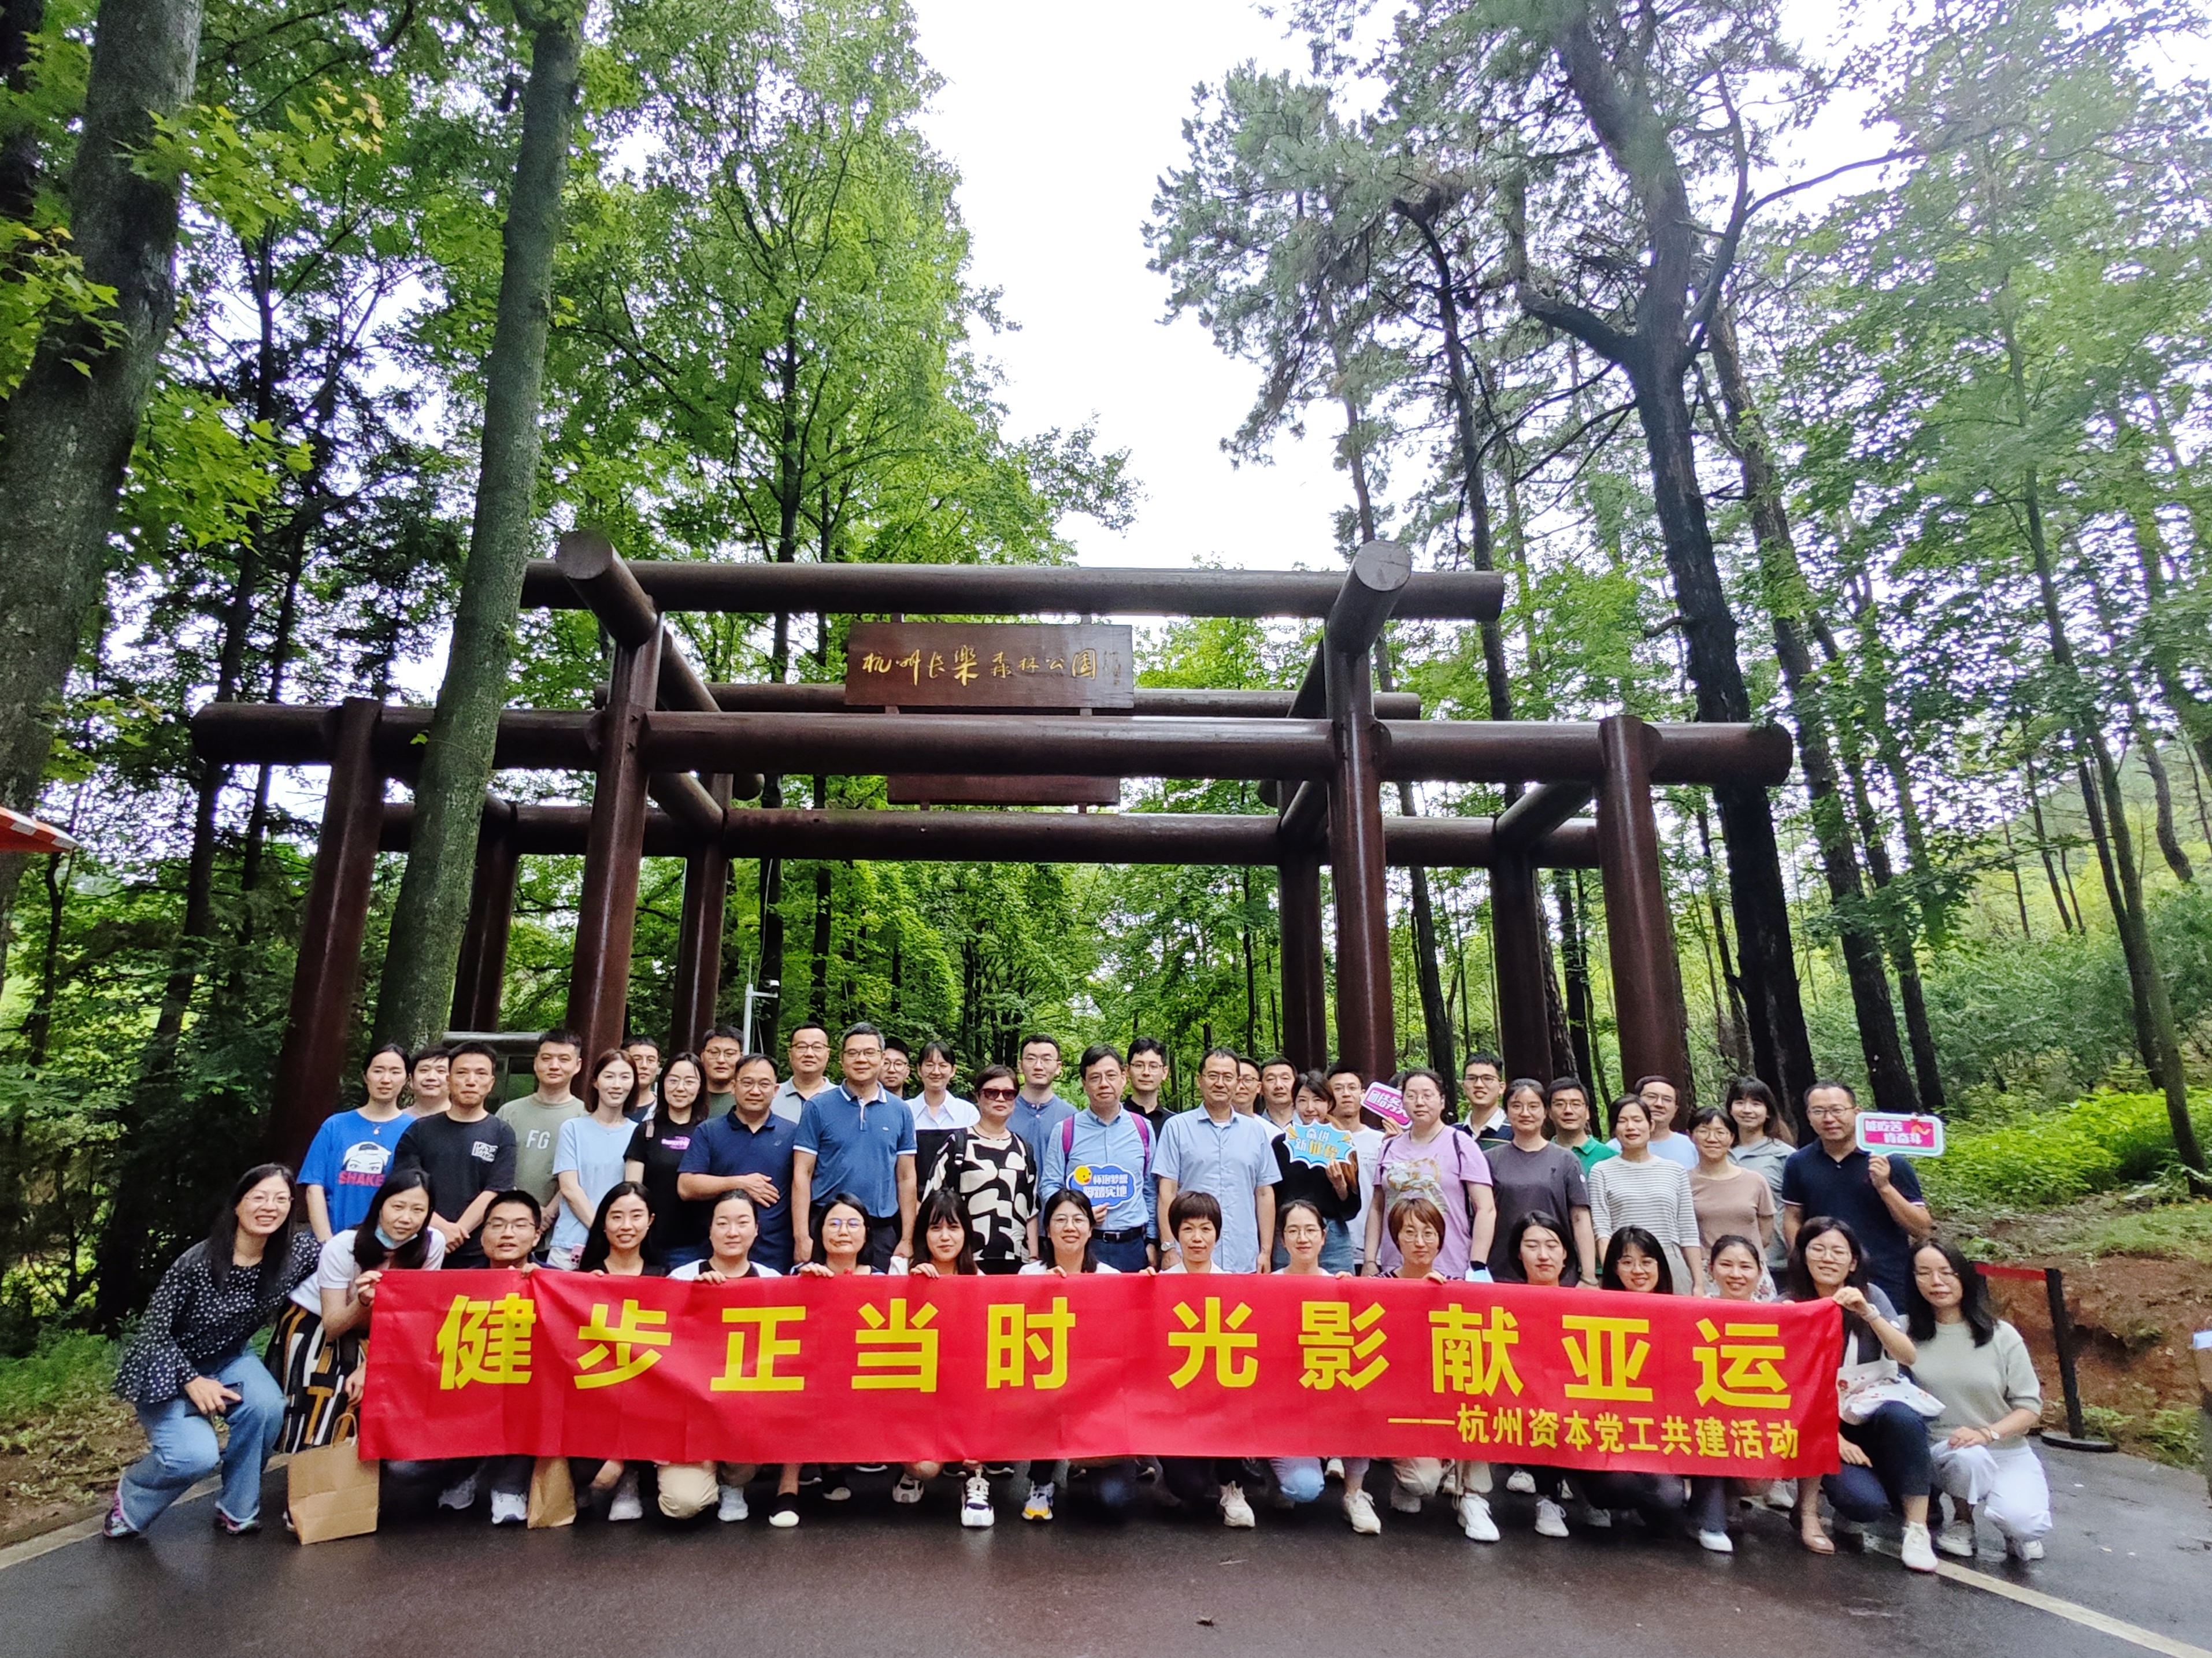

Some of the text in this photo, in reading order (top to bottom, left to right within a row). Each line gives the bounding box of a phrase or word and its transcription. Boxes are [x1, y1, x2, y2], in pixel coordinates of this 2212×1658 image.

[525, 1129, 550, 1149] FG
[338, 1170, 385, 1188] SHAKE
[436, 1293, 1791, 1410] 健步正当时 光影献亚运
